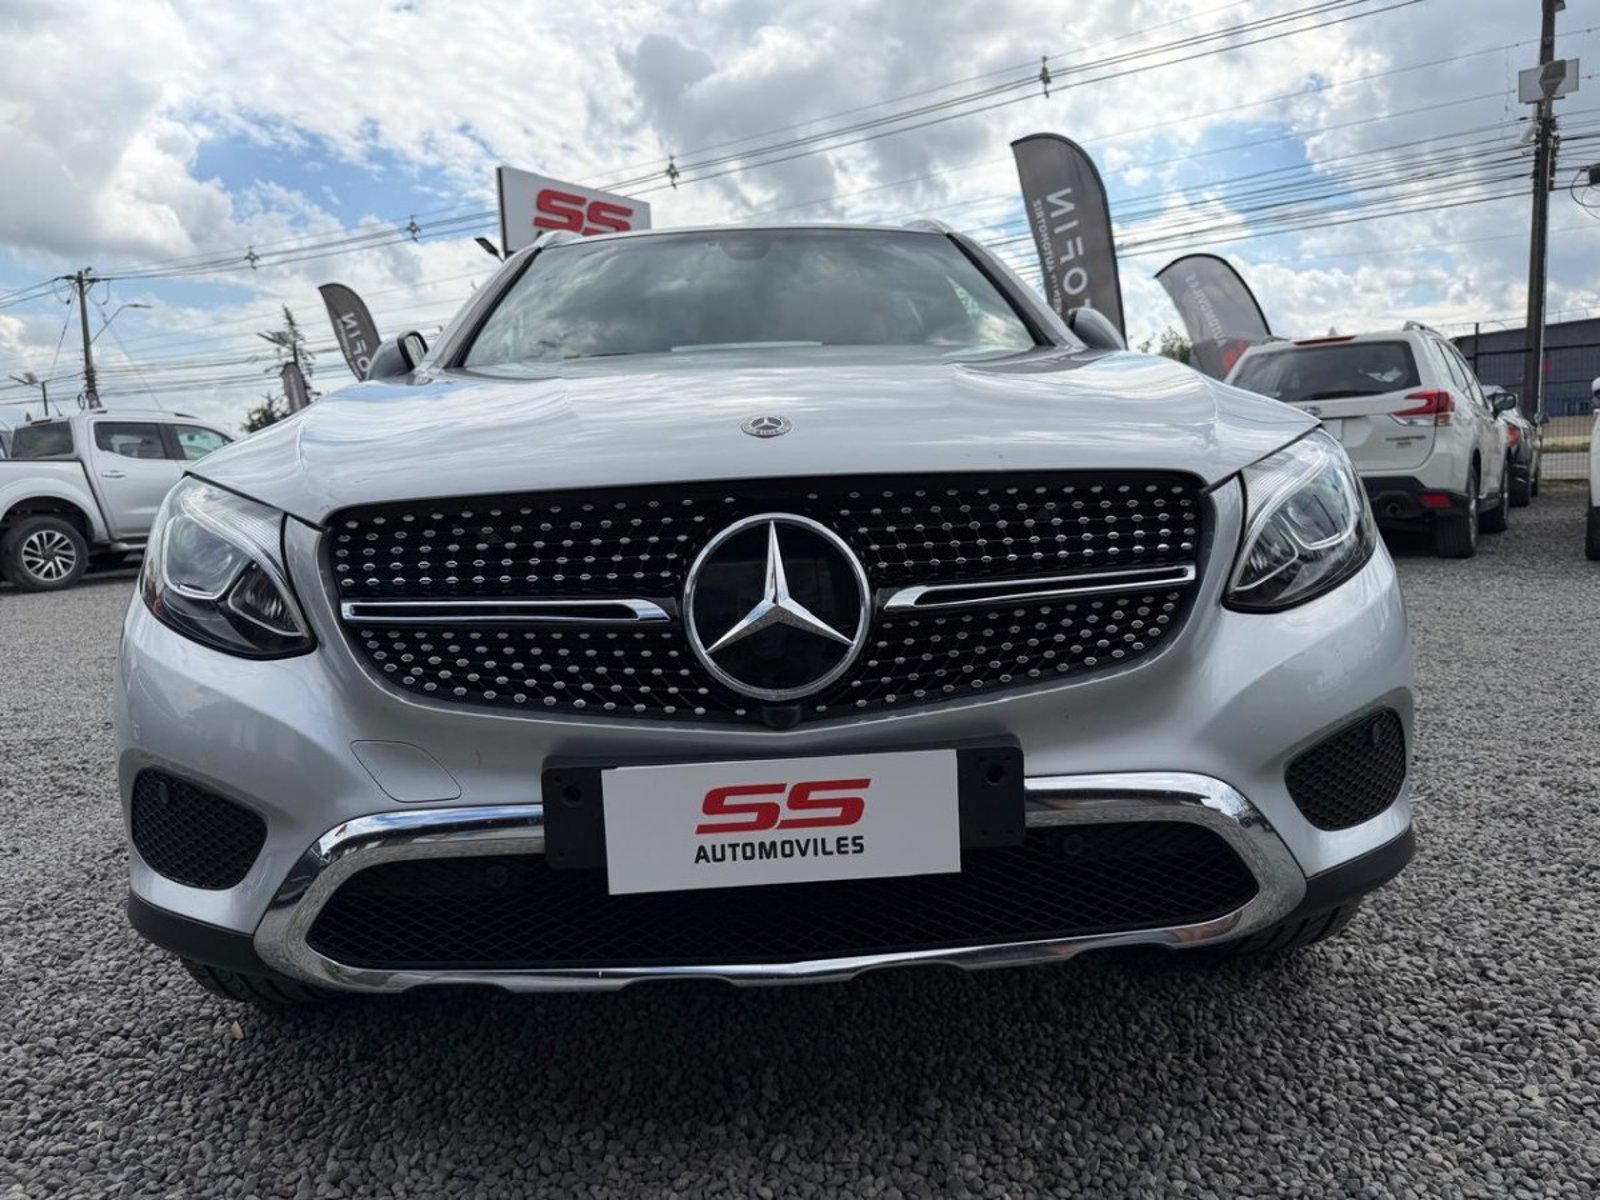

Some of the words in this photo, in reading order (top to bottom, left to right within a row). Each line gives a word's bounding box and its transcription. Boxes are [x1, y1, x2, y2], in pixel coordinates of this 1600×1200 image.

[533, 188, 635, 238] SS
[695, 778, 872, 835] SS
[694, 834, 865, 865] AUTOMOVILES
